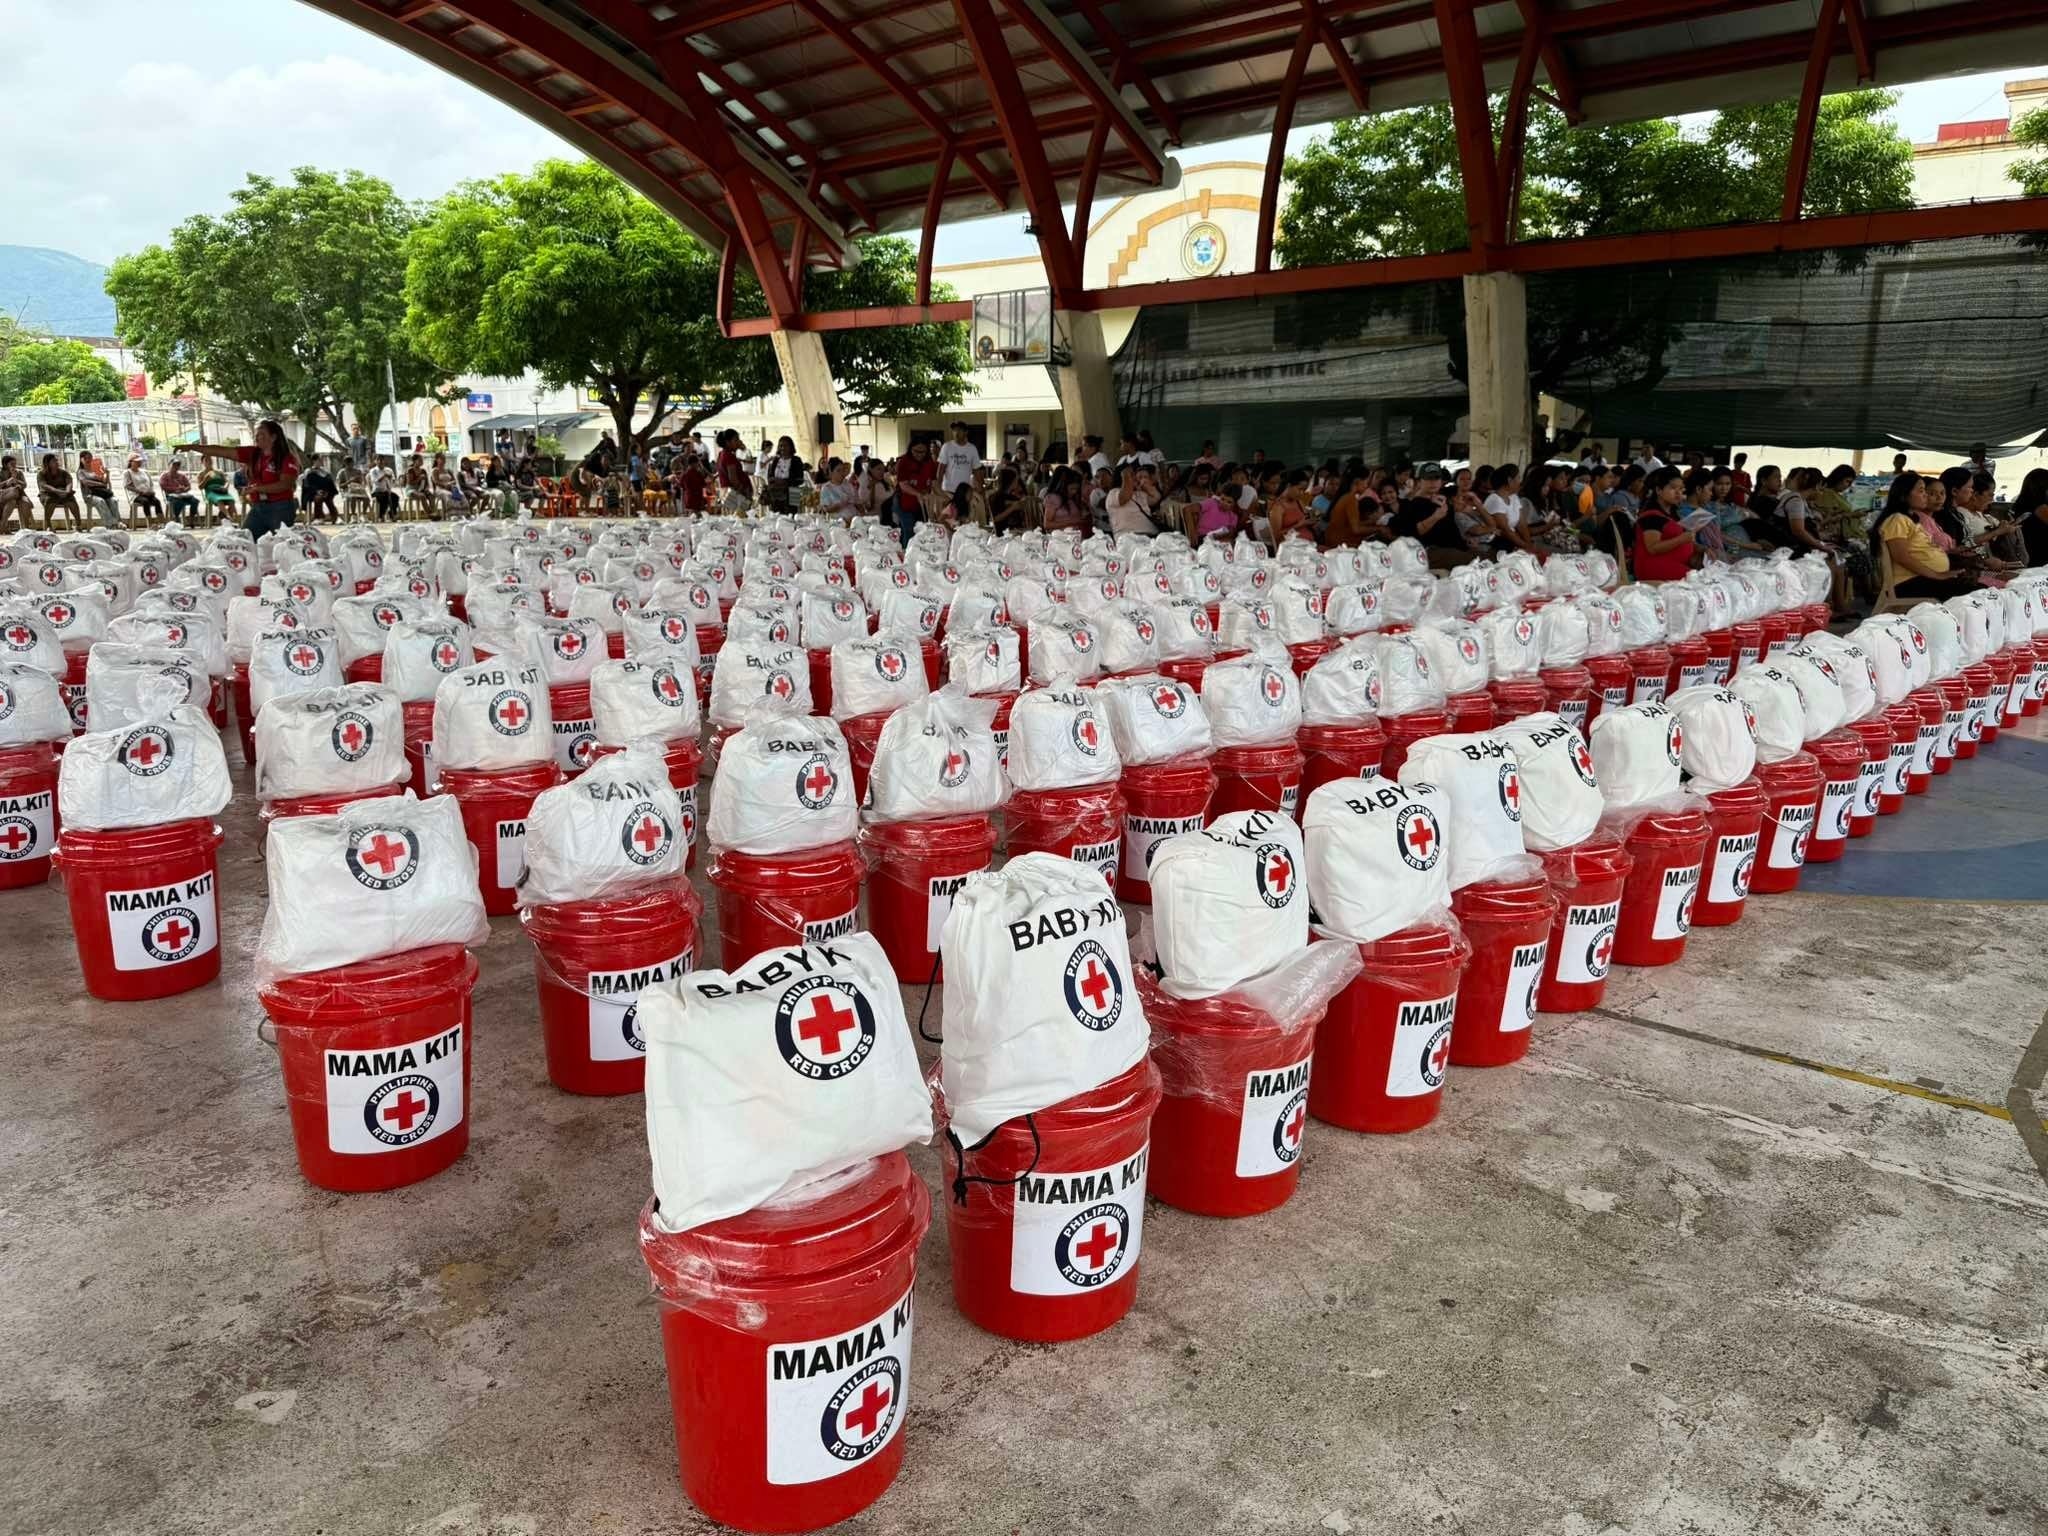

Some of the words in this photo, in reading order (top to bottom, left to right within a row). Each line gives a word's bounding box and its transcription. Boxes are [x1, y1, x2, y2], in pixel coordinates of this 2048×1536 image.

[1637, 678, 1663, 687] MAMA
[553, 721, 591, 734] MAMA
[768, 740, 816, 752] BAB
[27, 792, 50, 811] KIT
[1345, 785, 1410, 815] BABY
[500, 822, 526, 837] MA
[1129, 817, 1178, 834] MAMA
[1183, 816, 1203, 833] KIT
[1074, 843, 1115, 862] MAMA
[1404, 853, 1422, 869] RED
[358, 872, 381, 888] RED
[386, 859, 417, 888] CROSS
[110, 888, 181, 911] MAMA
[187, 874, 212, 897] KIT
[146, 908, 196, 931] PHILIPPINE
[1009, 907, 1090, 951] BABY
[1570, 905, 1616, 925] MAMA
[150, 947, 169, 960] RED
[172, 937, 199, 960] CROSS
[1066, 940, 1108, 977] PHILIPPINE
[1514, 943, 1546, 968] MAM
[592, 967, 664, 995] MAMA
[670, 951, 693, 980] KIT
[697, 944, 814, 999] BABY
[1076, 1009, 1099, 1029] RED
[1101, 993, 1122, 1029] CROSS
[1400, 997, 1454, 1026] MAMA
[328, 1048, 417, 1077] MAMA
[425, 1028, 460, 1064] KIT
[789, 1053, 822, 1078] RED
[829, 1033, 873, 1077] CROSS
[369, 1077, 436, 1105] PHILIPPINE
[1249, 1061, 1308, 1098] MAMA
[372, 1127, 396, 1143] RED
[400, 1114, 435, 1143] CROSS
[1019, 1171, 1114, 1204] MAMA
[1121, 1145, 1149, 1190] KIT
[1063, 1205, 1128, 1239] PHILIPPINE
[1062, 1265, 1086, 1285] RED
[1090, 1249, 1124, 1285] CROSS
[773, 1323, 886, 1380] MAMA
[830, 1359, 899, 1410] PHILIPPINE
[831, 1439, 858, 1459] RED
[862, 1404, 897, 1454] CROSS
